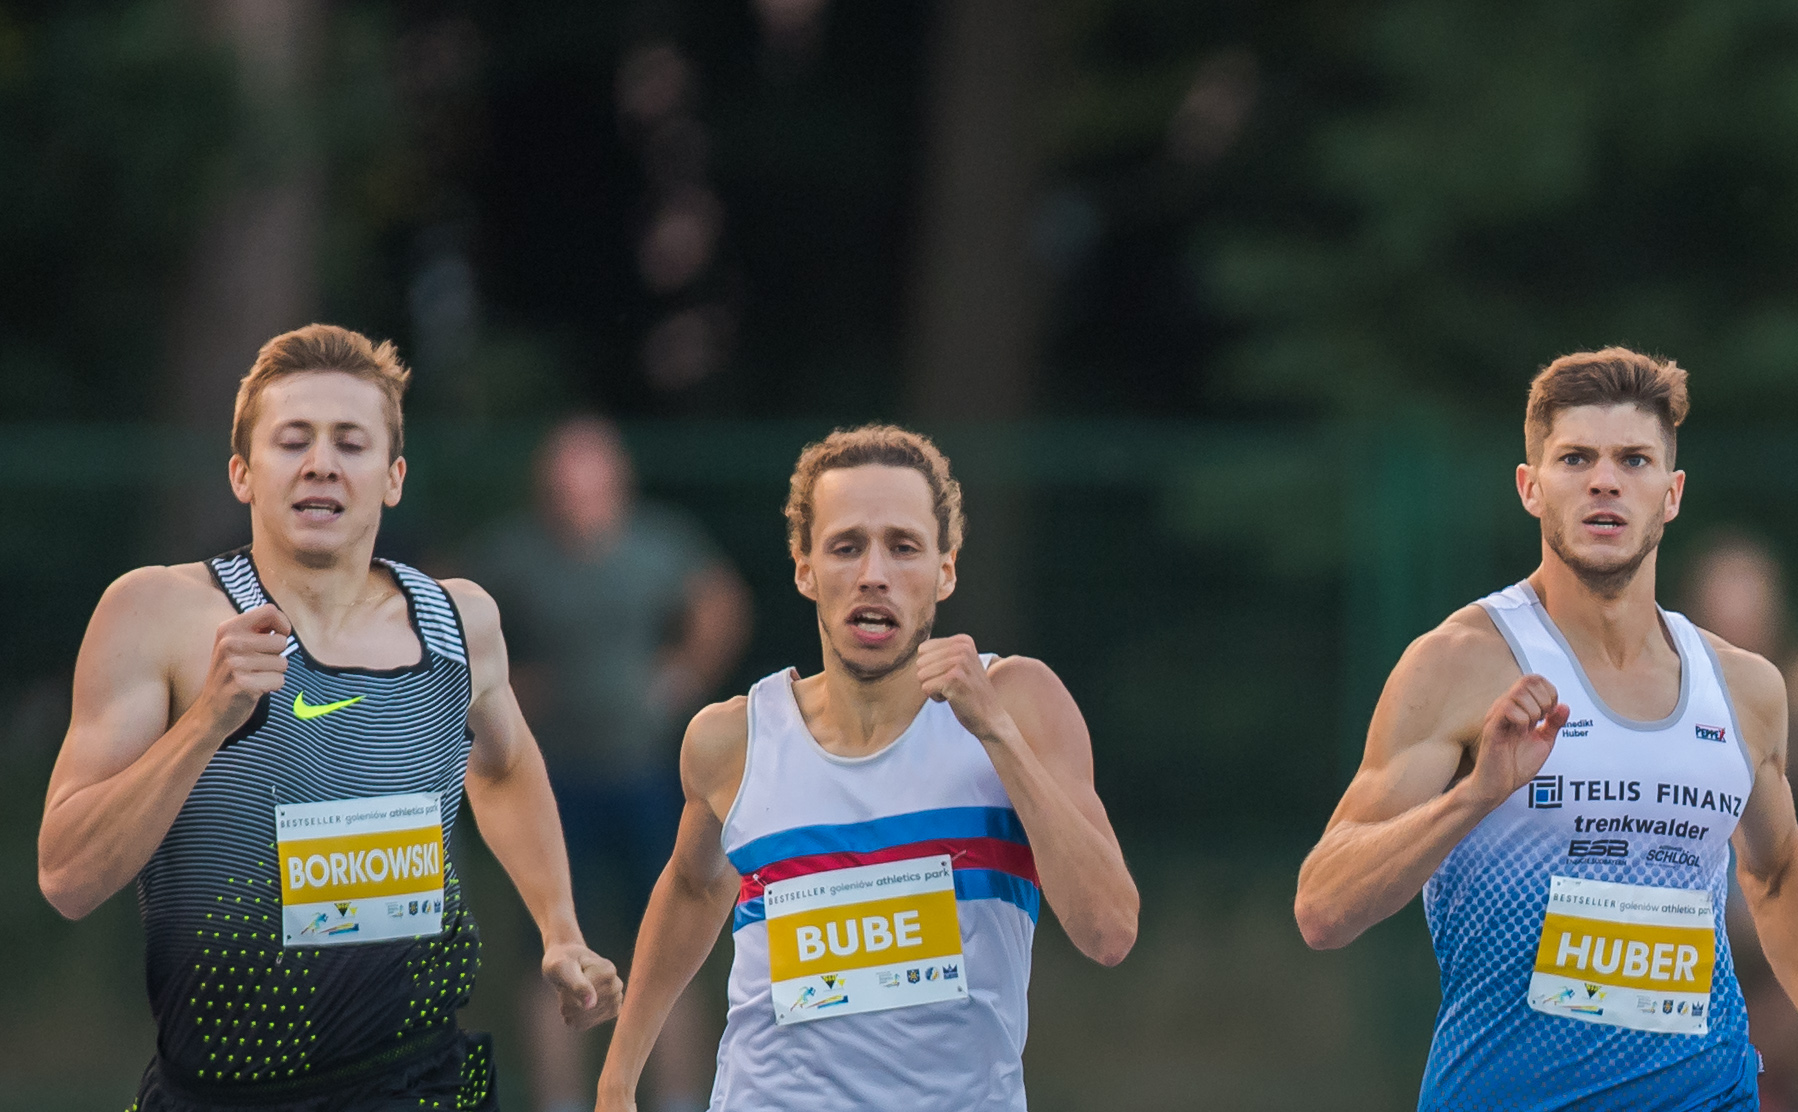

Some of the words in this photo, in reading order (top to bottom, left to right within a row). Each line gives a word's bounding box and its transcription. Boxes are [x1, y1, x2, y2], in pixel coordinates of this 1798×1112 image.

[1562, 729, 1589, 738] Huber
[1564, 719, 1593, 728] nedikt
[1570, 780, 1641, 802] TELIS
[1657, 783, 1742, 817] FINANZ
[280, 815, 342, 829] BESTSELLER
[345, 810, 387, 824] goleniów
[389, 806, 425, 818] athletics
[425, 804, 438, 815] park
[1574, 814, 1710, 841] trenkwalder
[1568, 839, 1629, 857] ESB
[1646, 849, 1700, 867] SCHLÖGL
[288, 841, 440, 890] BORKOWSKI
[768, 887, 826, 906] BESTSELLER
[829, 881, 874, 895] goleniów
[876, 872, 921, 886] athletics
[924, 868, 950, 882] park
[1553, 893, 1616, 908] BESTSELLER
[1620, 901, 1659, 912] goleniów
[1661, 903, 1696, 914] athletics
[796, 909, 923, 962] BUBE
[1556, 932, 1699, 982] HUBER
